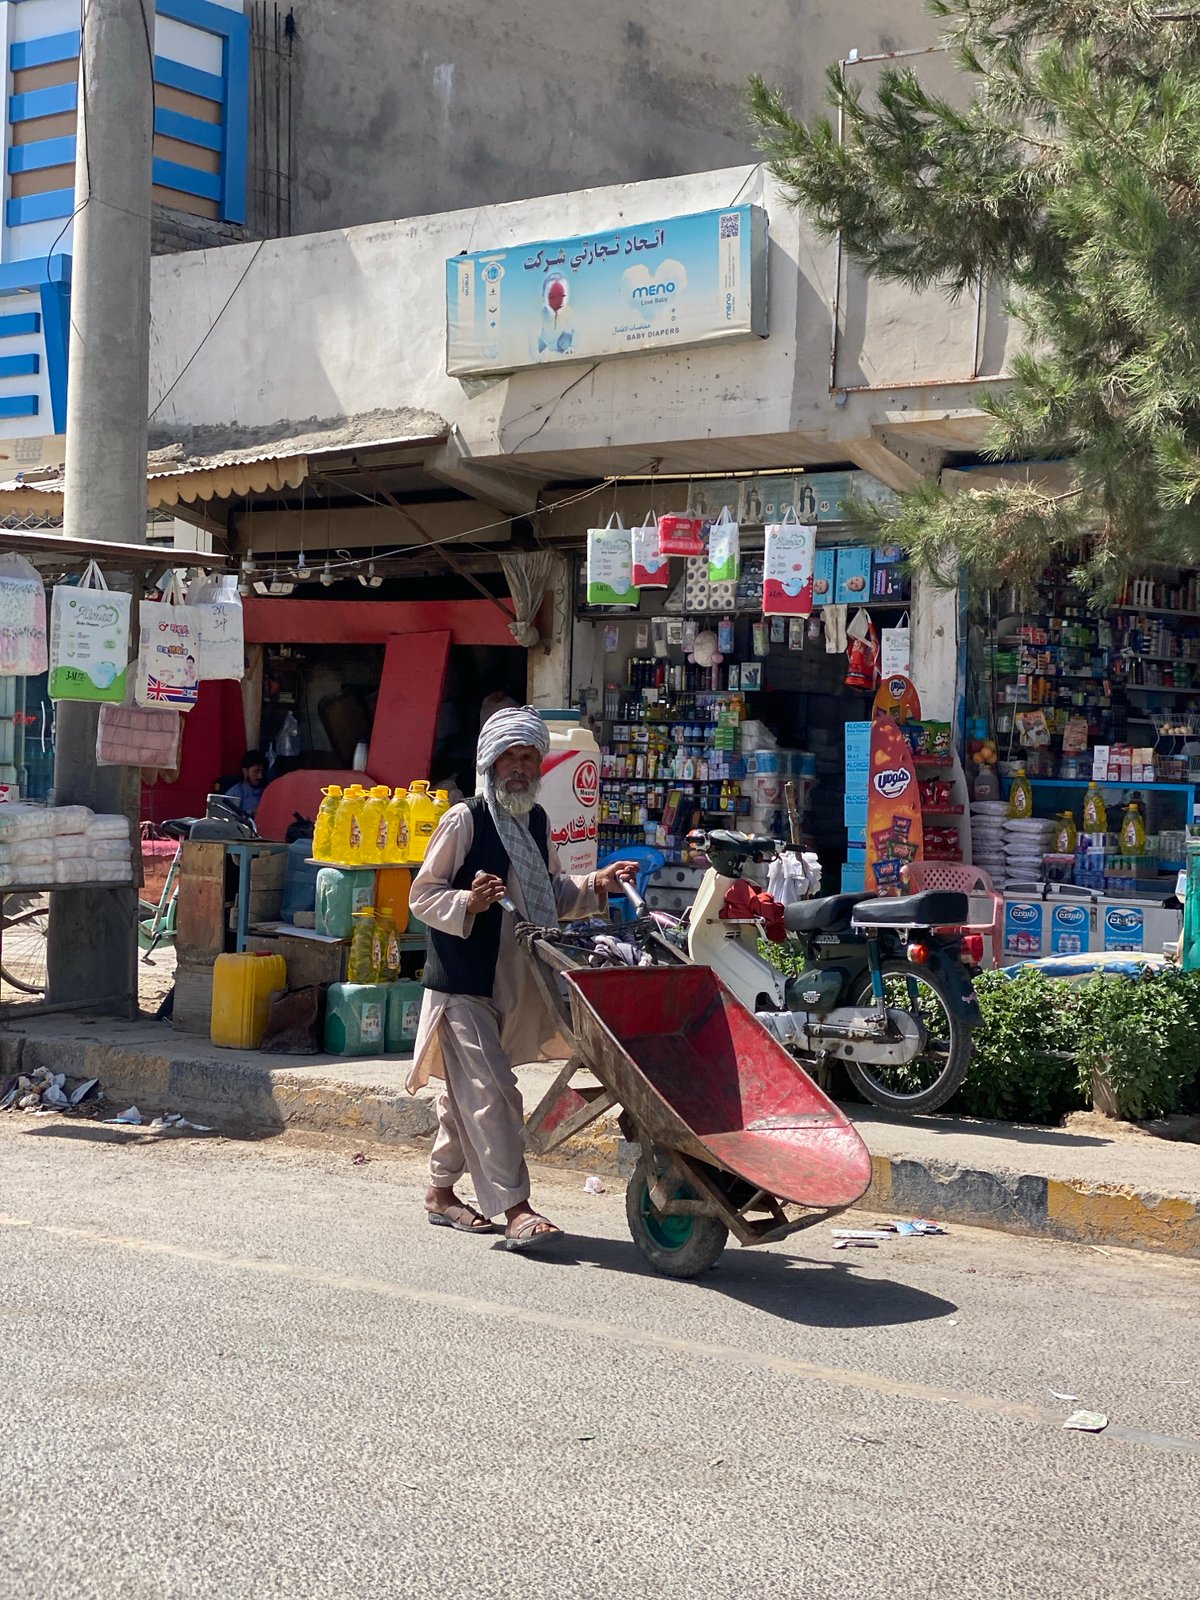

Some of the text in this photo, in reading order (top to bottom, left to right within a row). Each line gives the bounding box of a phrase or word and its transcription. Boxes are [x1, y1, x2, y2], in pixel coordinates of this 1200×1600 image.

[624, 229, 665, 255] اتحاد
[654, 296, 668, 304] Baby
[626, 327, 680, 341] BABY DIAPERS
